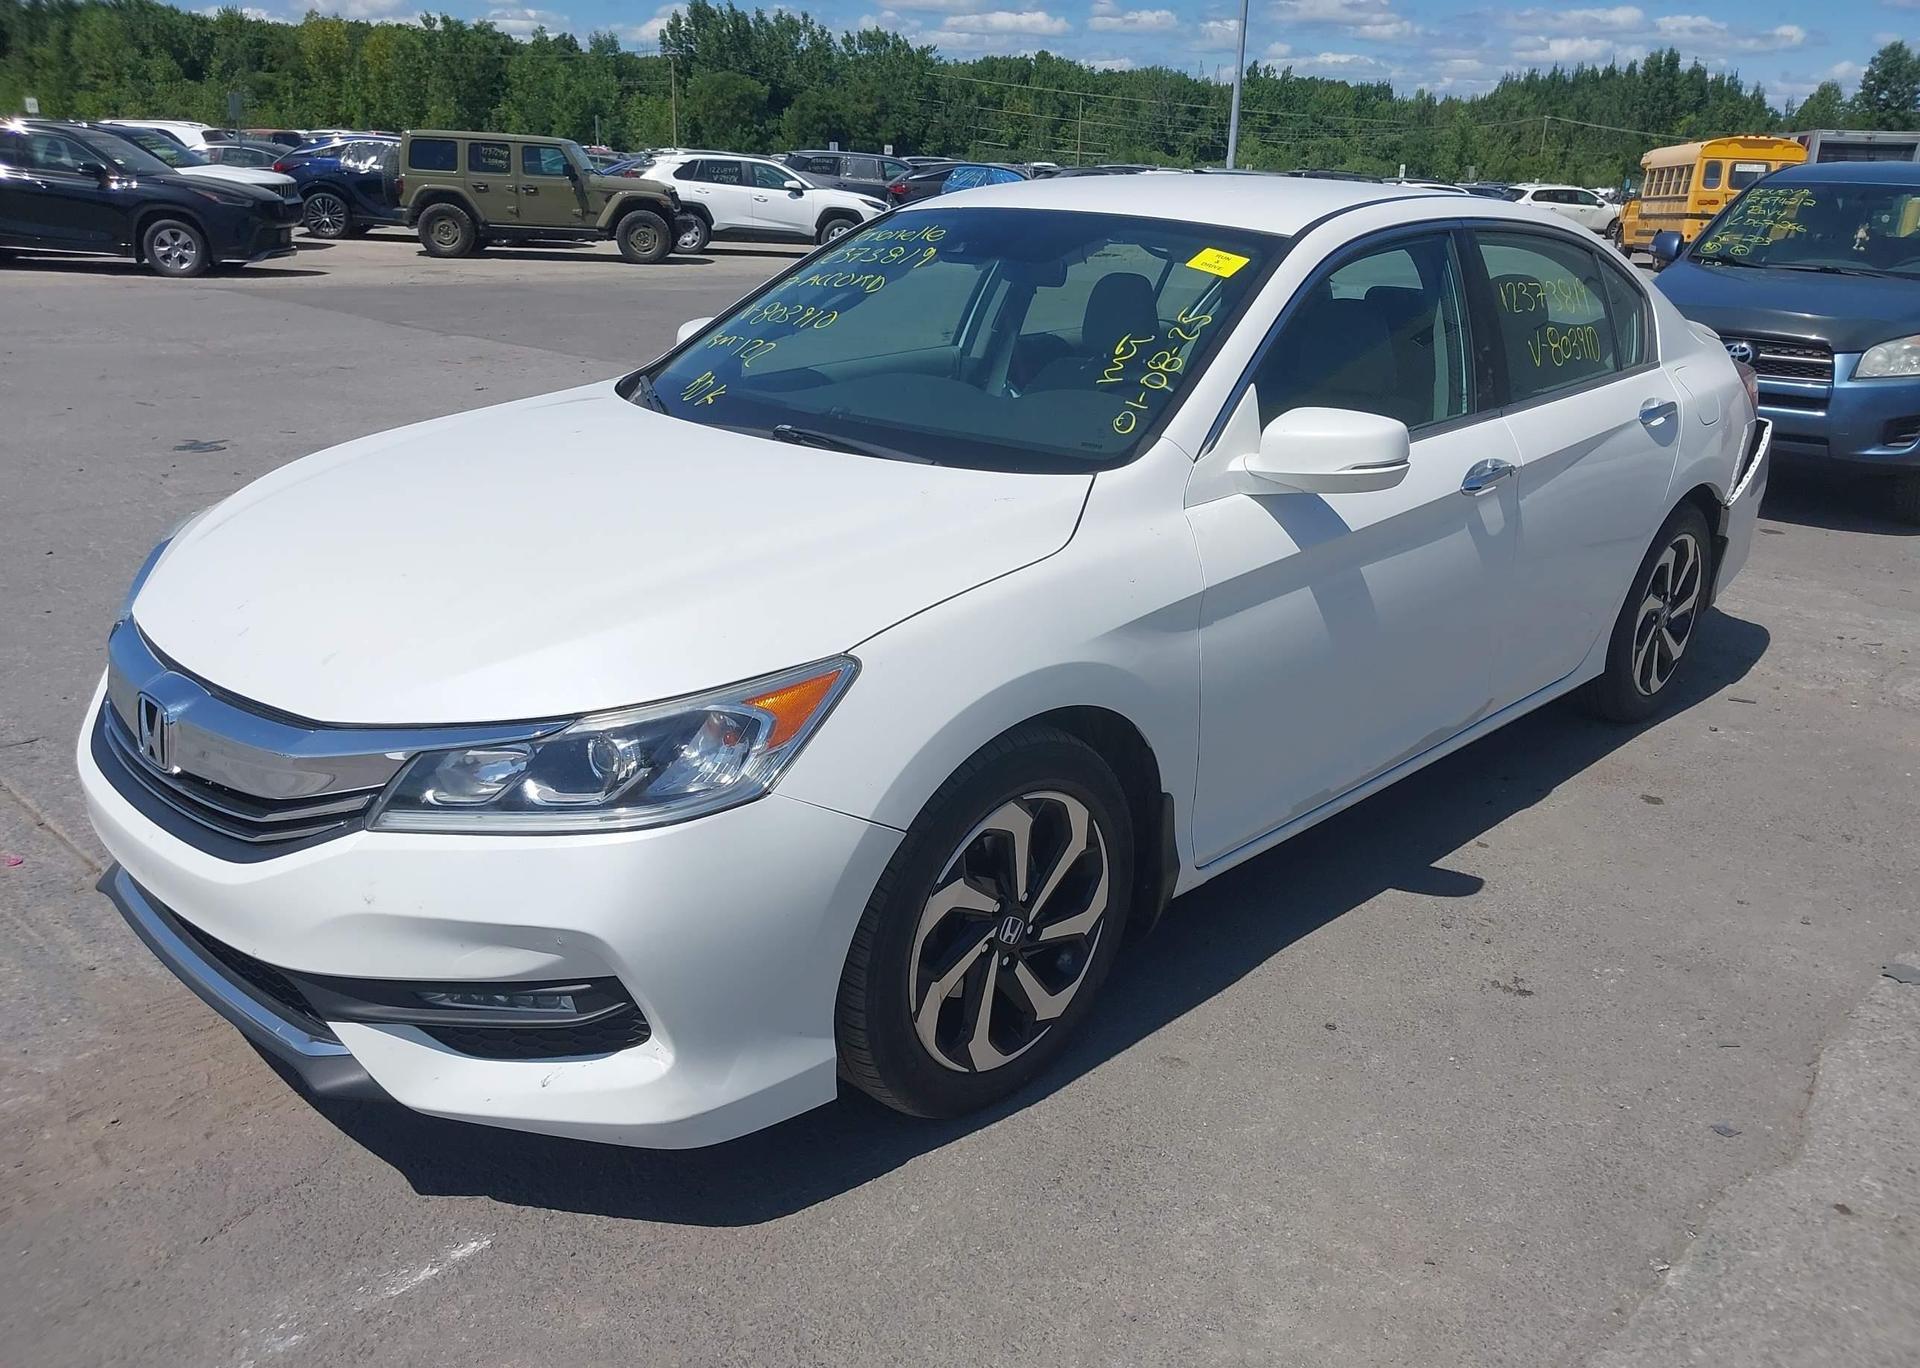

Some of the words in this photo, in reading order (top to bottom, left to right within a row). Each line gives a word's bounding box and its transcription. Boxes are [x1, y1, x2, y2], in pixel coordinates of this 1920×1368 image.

[1200, 261, 1225, 271] DRIVE
[799, 272, 886, 293] ACCORD
[1498, 276, 1592, 315] 12373819
